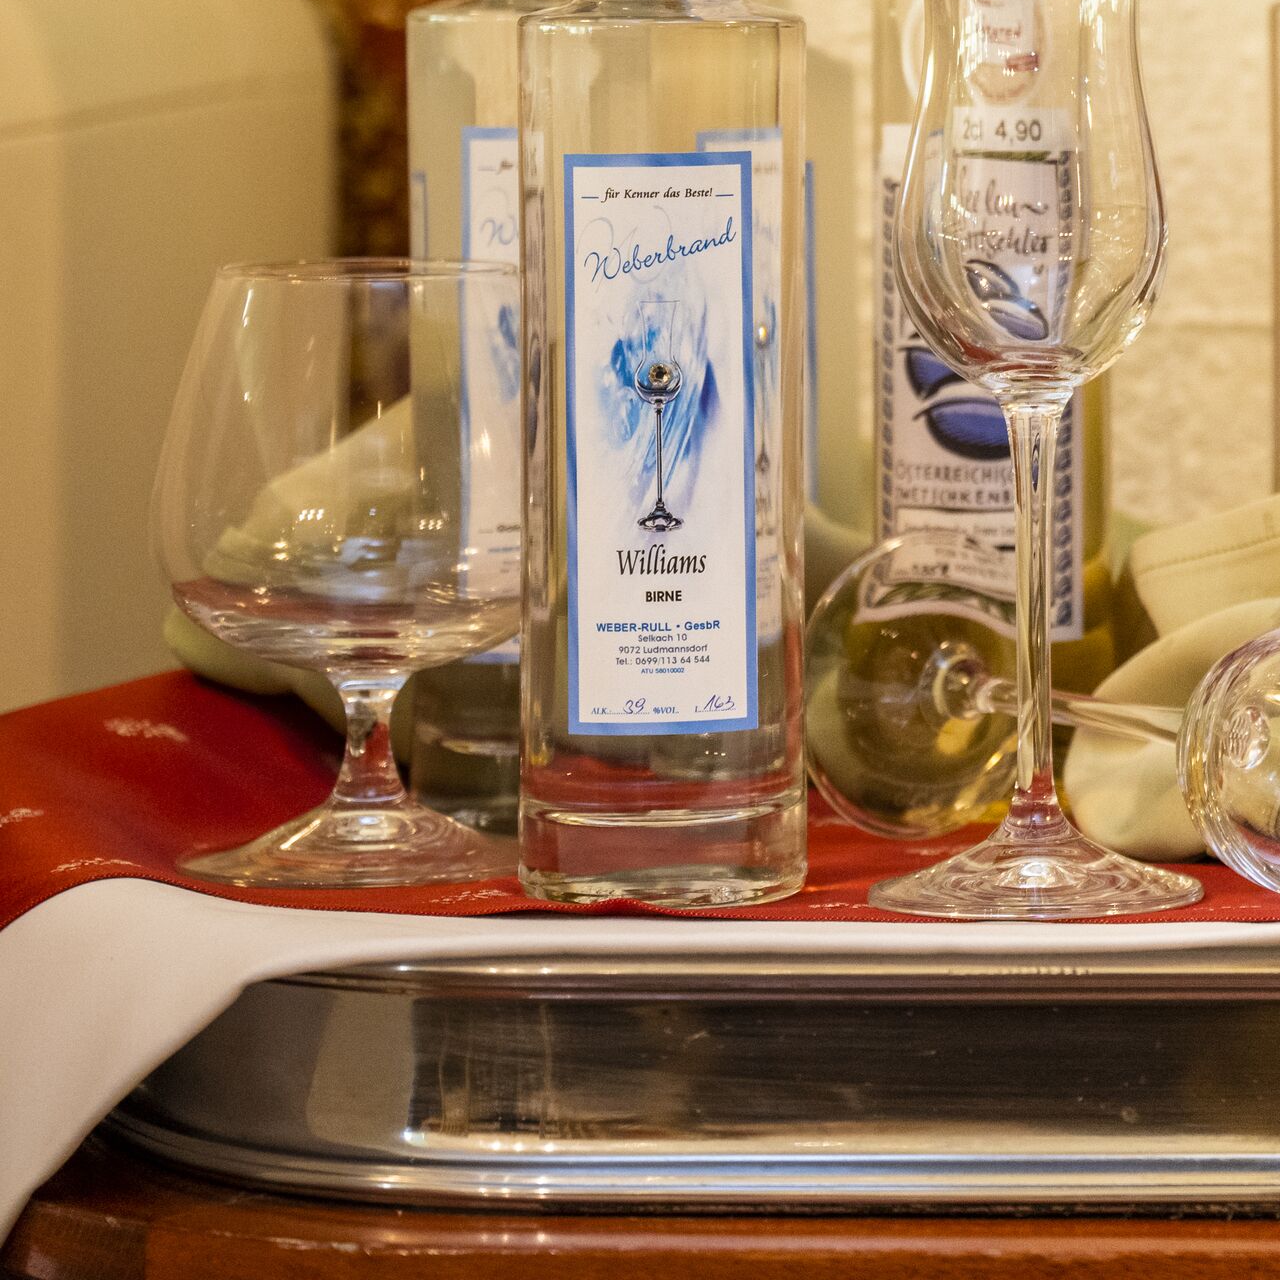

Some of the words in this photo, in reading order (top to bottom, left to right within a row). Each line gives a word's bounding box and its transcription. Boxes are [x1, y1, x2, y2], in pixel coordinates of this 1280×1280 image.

[995, 120, 1042, 146] 4,90
[601, 188, 620, 203] für
[624, 189, 660, 199] Kenner
[664, 187, 680, 198] das
[685, 187, 712, 198] Beste!
[584, 216, 737, 282] Weberbrand
[617, 544, 707, 575] Williams
[645, 590, 682, 602] BIRNE
[596, 622, 671, 632] WEBER-RULL
[684, 620, 720, 631] GesbR
[638, 634, 673, 642] Selkach
[676, 634, 687, 642] 10
[618, 646, 640, 654] 9072
[643, 644, 708, 654] Ludmannsdorf
[616, 657, 632, 665] Tel.:
[635, 656, 677, 665] 0699/113
[680, 656, 691, 664] 64
[694, 655, 710, 663] 544
